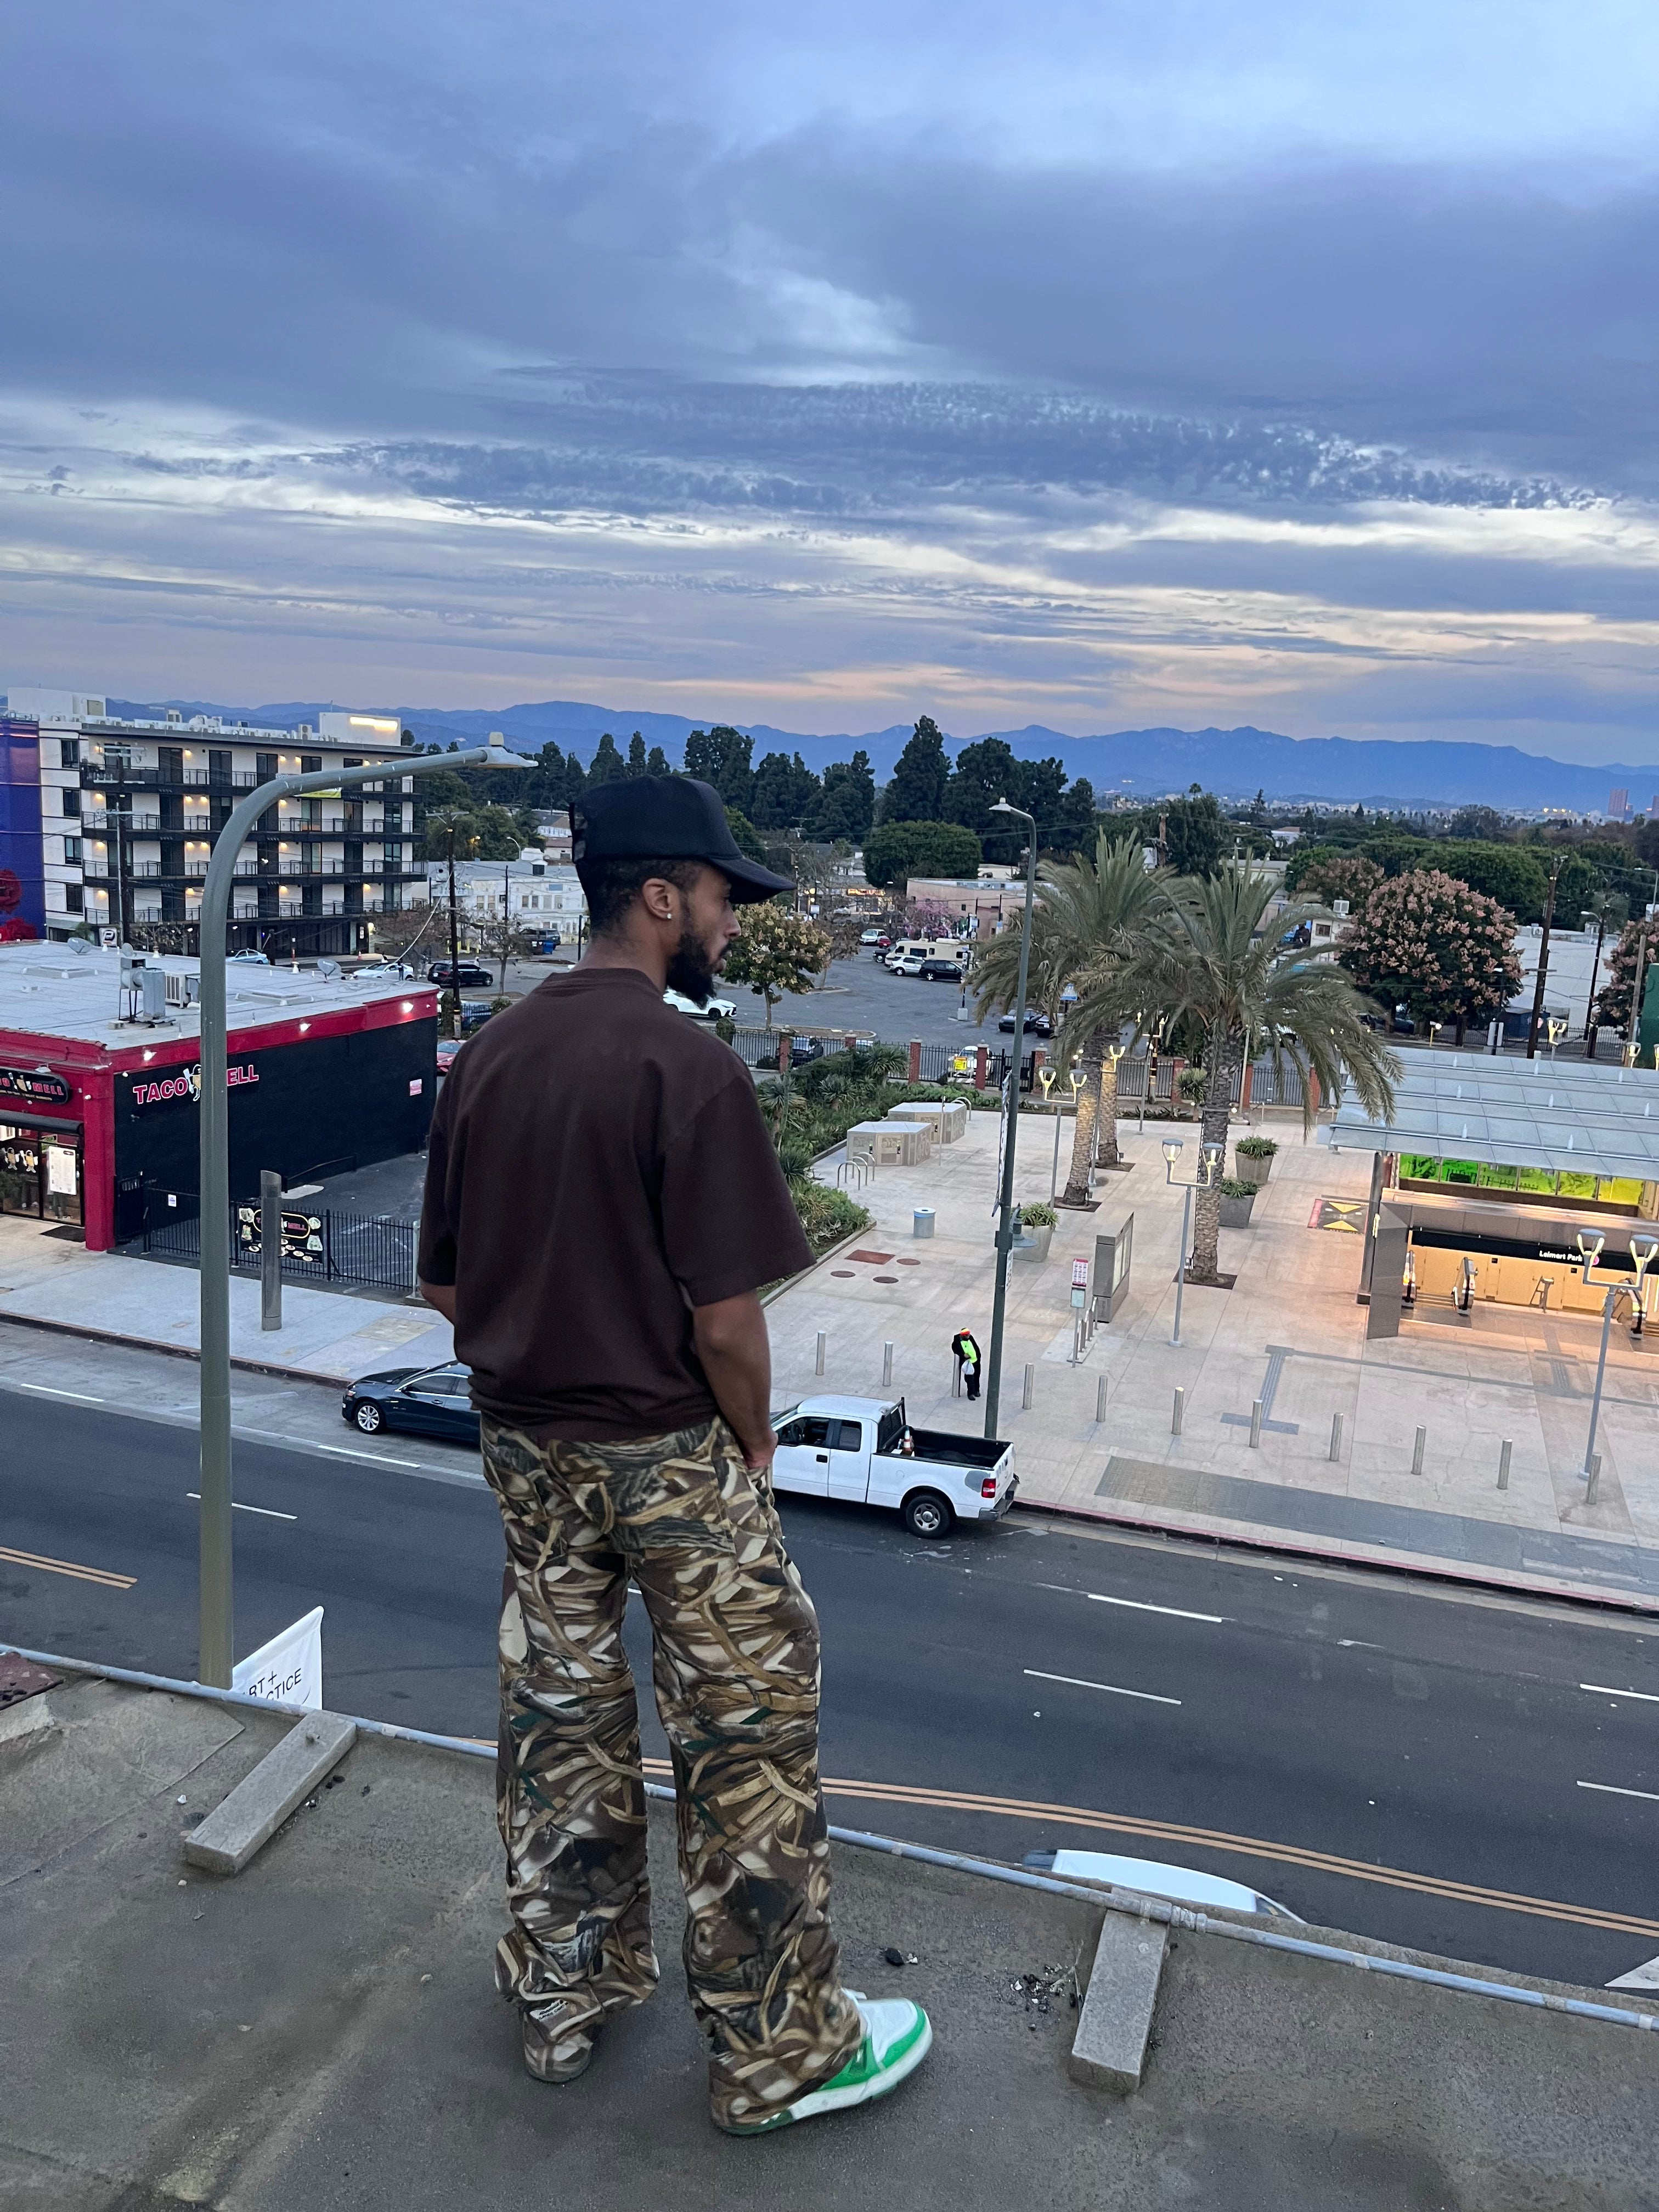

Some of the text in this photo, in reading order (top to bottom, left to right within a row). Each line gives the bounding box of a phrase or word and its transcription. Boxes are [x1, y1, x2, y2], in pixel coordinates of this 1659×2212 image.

[32, 1082, 64, 1096] MELL
[133, 1065, 259, 1104] TACO ELL
[1539, 1250, 1583, 1262] Leimert Park
[243, 1677, 266, 1697] RT
